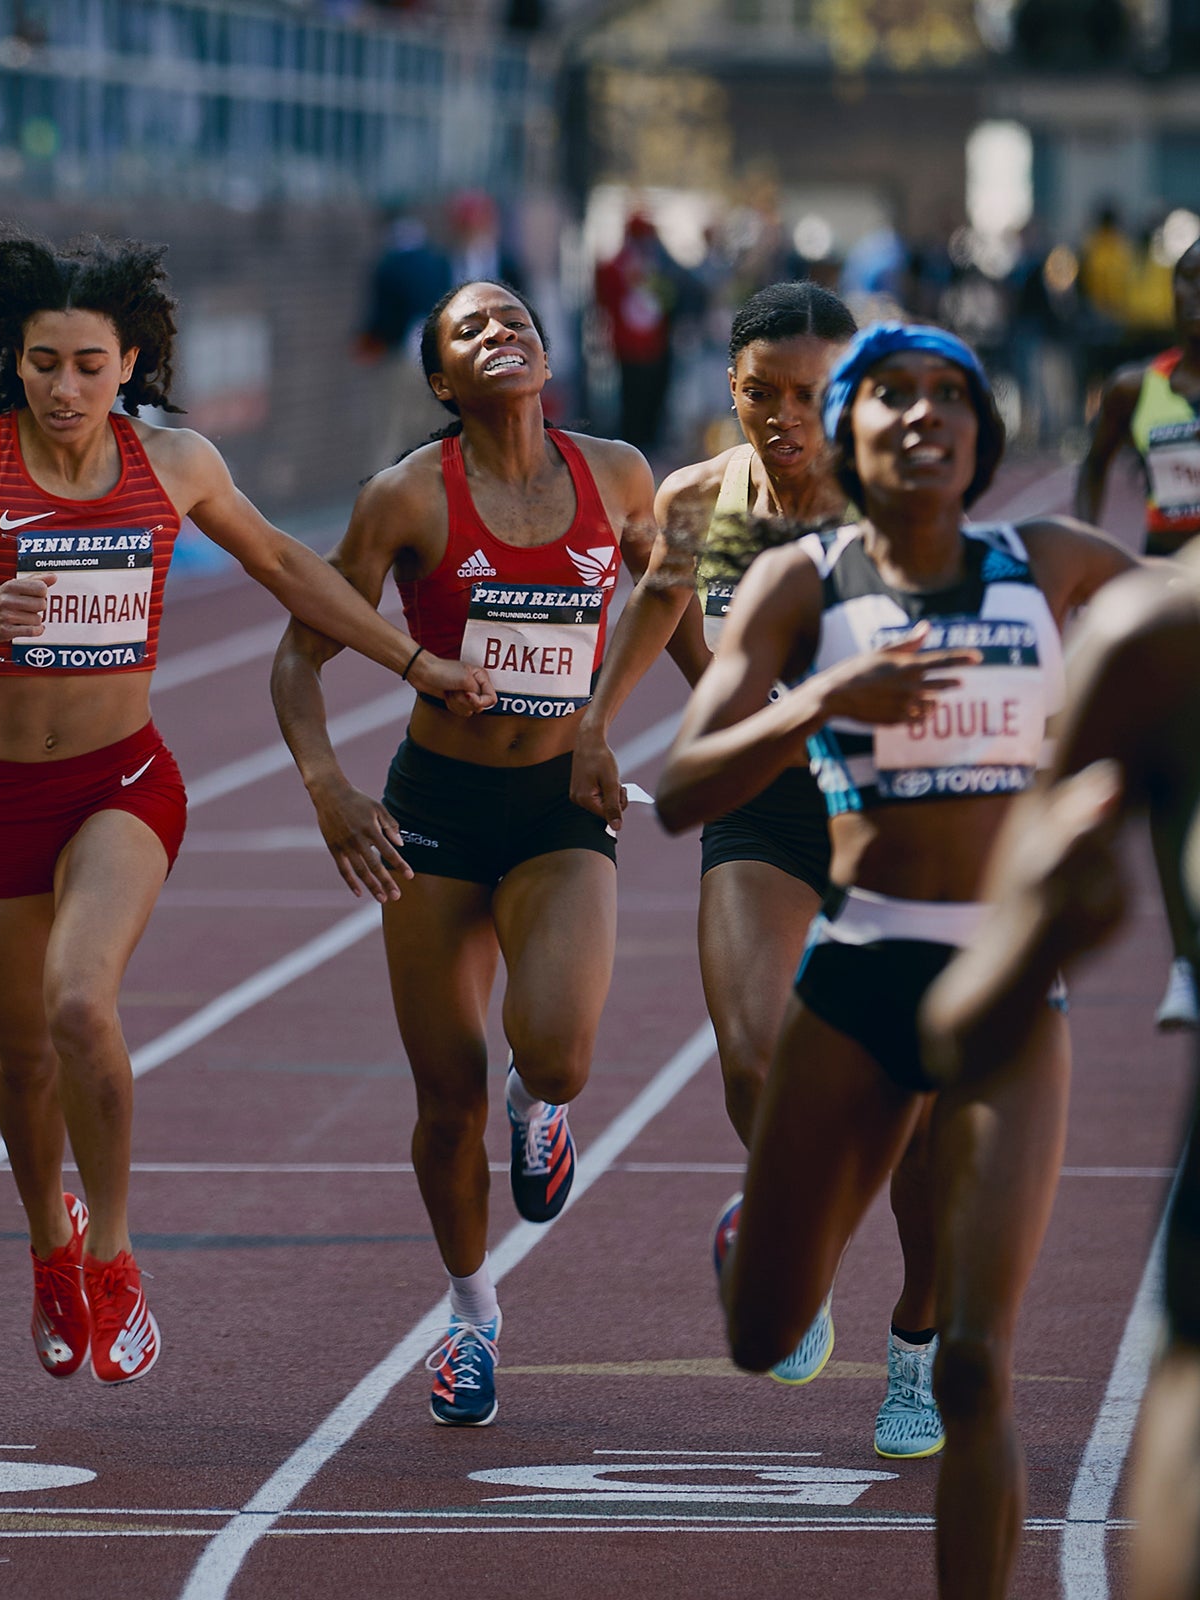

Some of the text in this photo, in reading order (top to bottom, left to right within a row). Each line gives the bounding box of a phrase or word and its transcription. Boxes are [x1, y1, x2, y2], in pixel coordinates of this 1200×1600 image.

[18, 535, 151, 554] PENN RELAYS
[35, 558, 99, 568] ON-RUNNING.COM
[457, 567, 497, 578] adidas
[472, 589, 602, 607] PENN RELAYS
[42, 592, 148, 624] RRIARAN
[487, 611, 549, 620] ON-RUNNING.COM
[59, 648, 136, 665] TOYOTA
[484, 637, 573, 676] BAKER
[500, 697, 575, 717] TOYOTA
[936, 769, 1029, 793] TOYOTA
